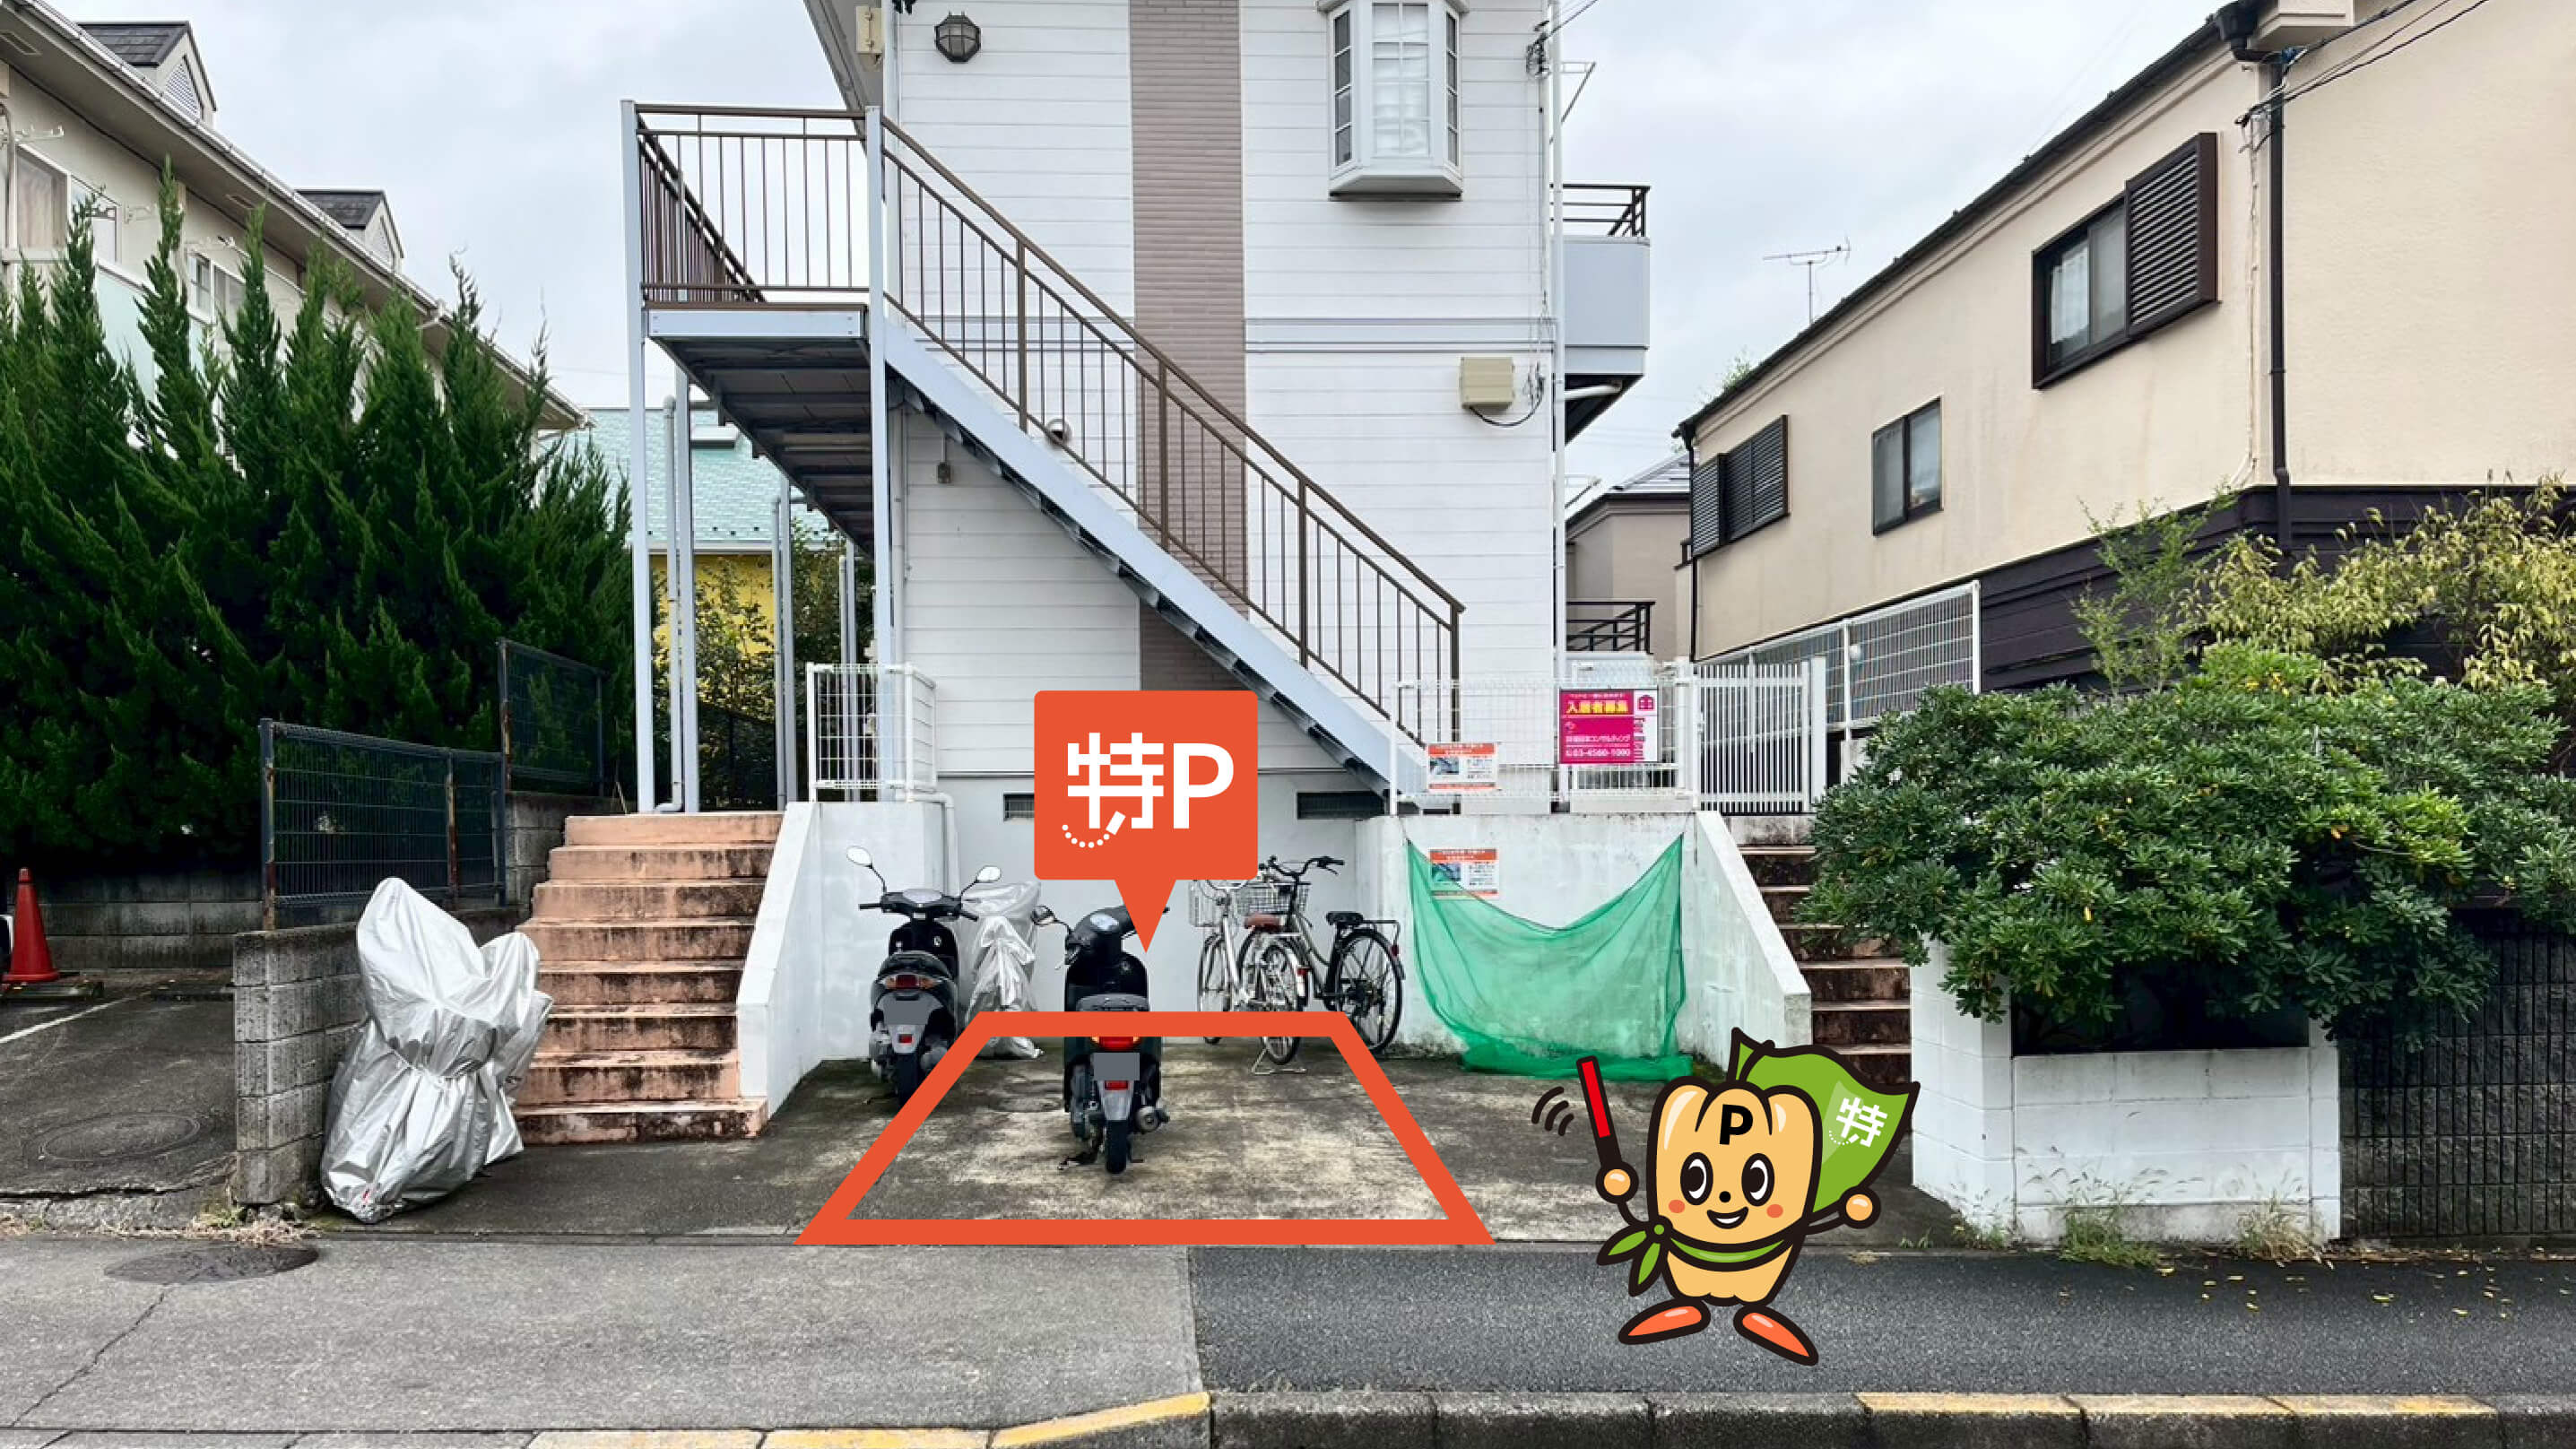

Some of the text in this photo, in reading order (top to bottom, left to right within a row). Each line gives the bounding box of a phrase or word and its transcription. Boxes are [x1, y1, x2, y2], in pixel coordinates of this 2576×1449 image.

[1566, 699, 1628, 714] 入居者募集
